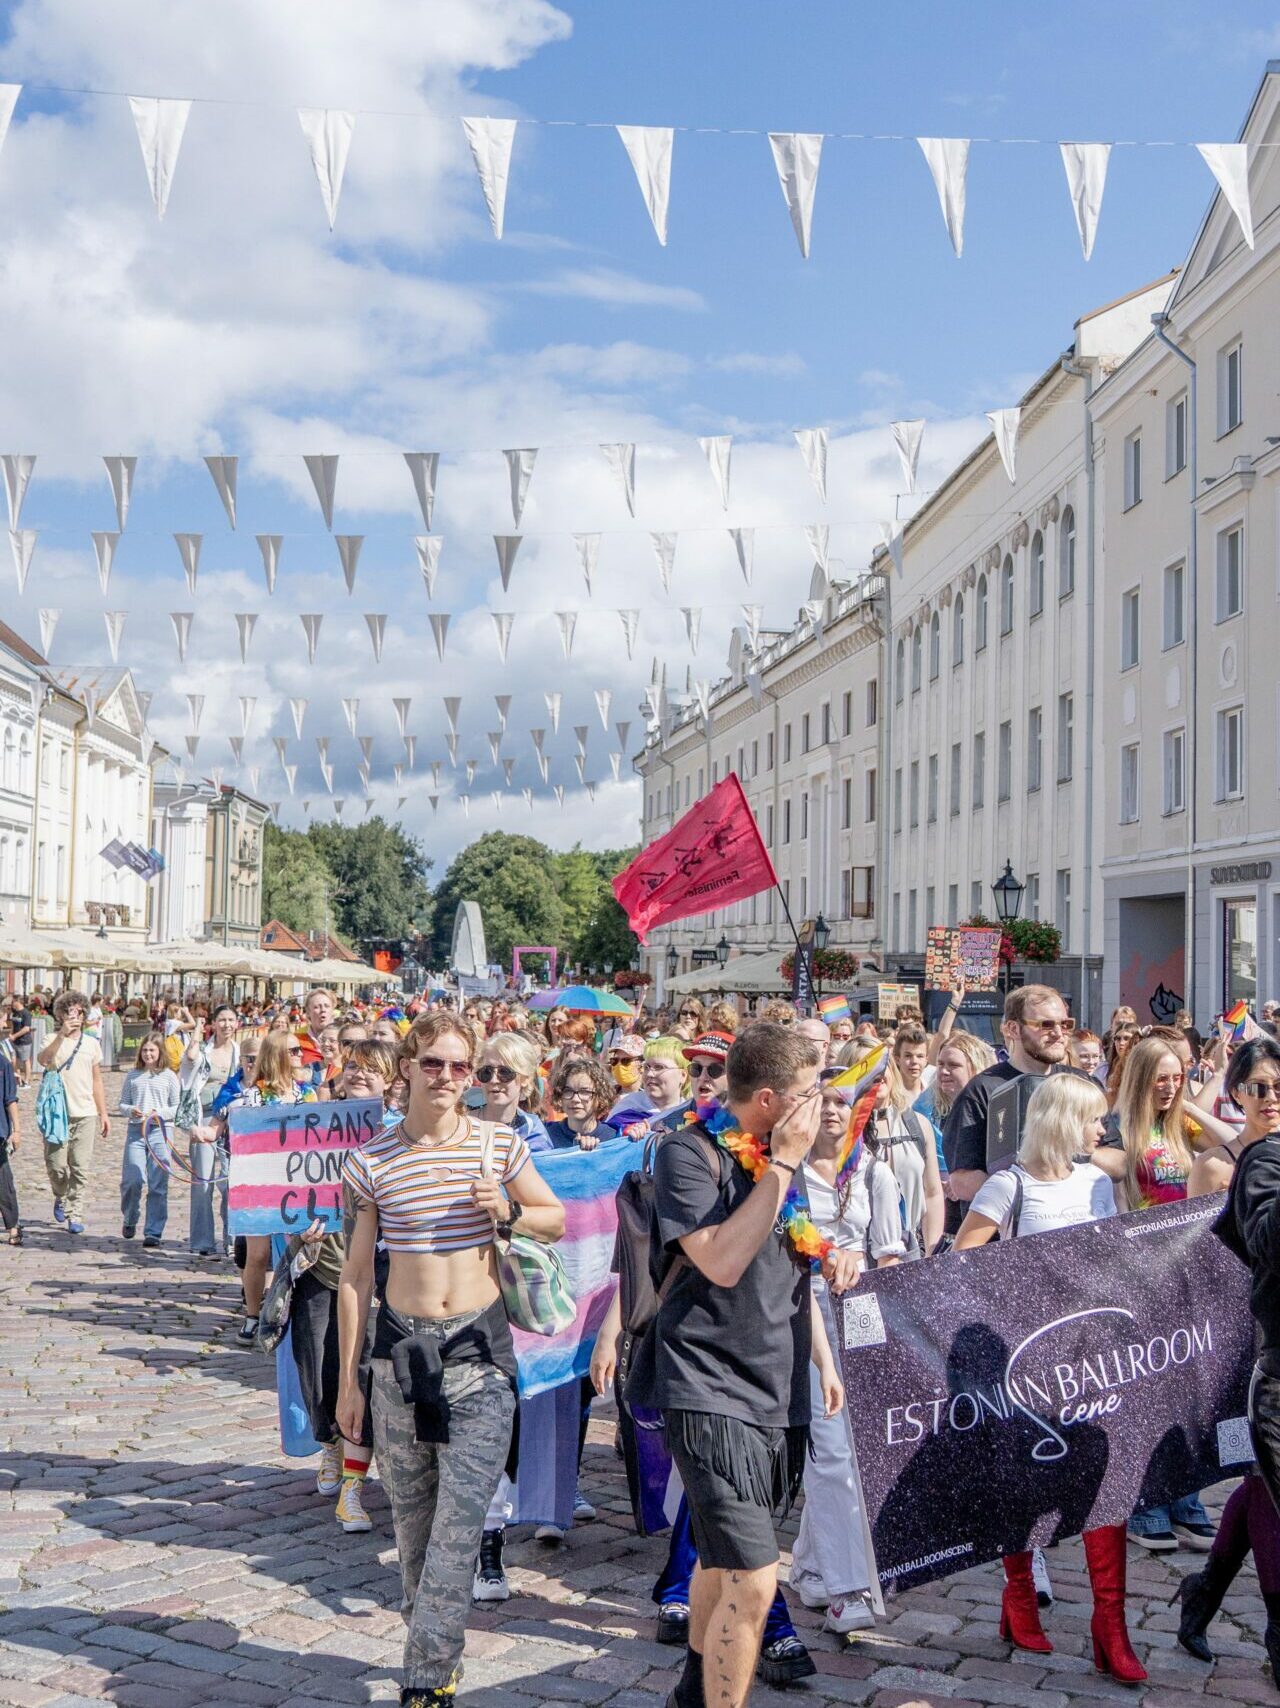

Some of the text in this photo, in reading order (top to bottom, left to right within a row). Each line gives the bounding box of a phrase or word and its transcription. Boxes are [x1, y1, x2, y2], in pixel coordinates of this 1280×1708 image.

[798, 951, 809, 1001] KTAILS
[263, 1110, 374, 1146] TRANS
[887, 1319, 1213, 1445] ESTONIAN BALLROOM
